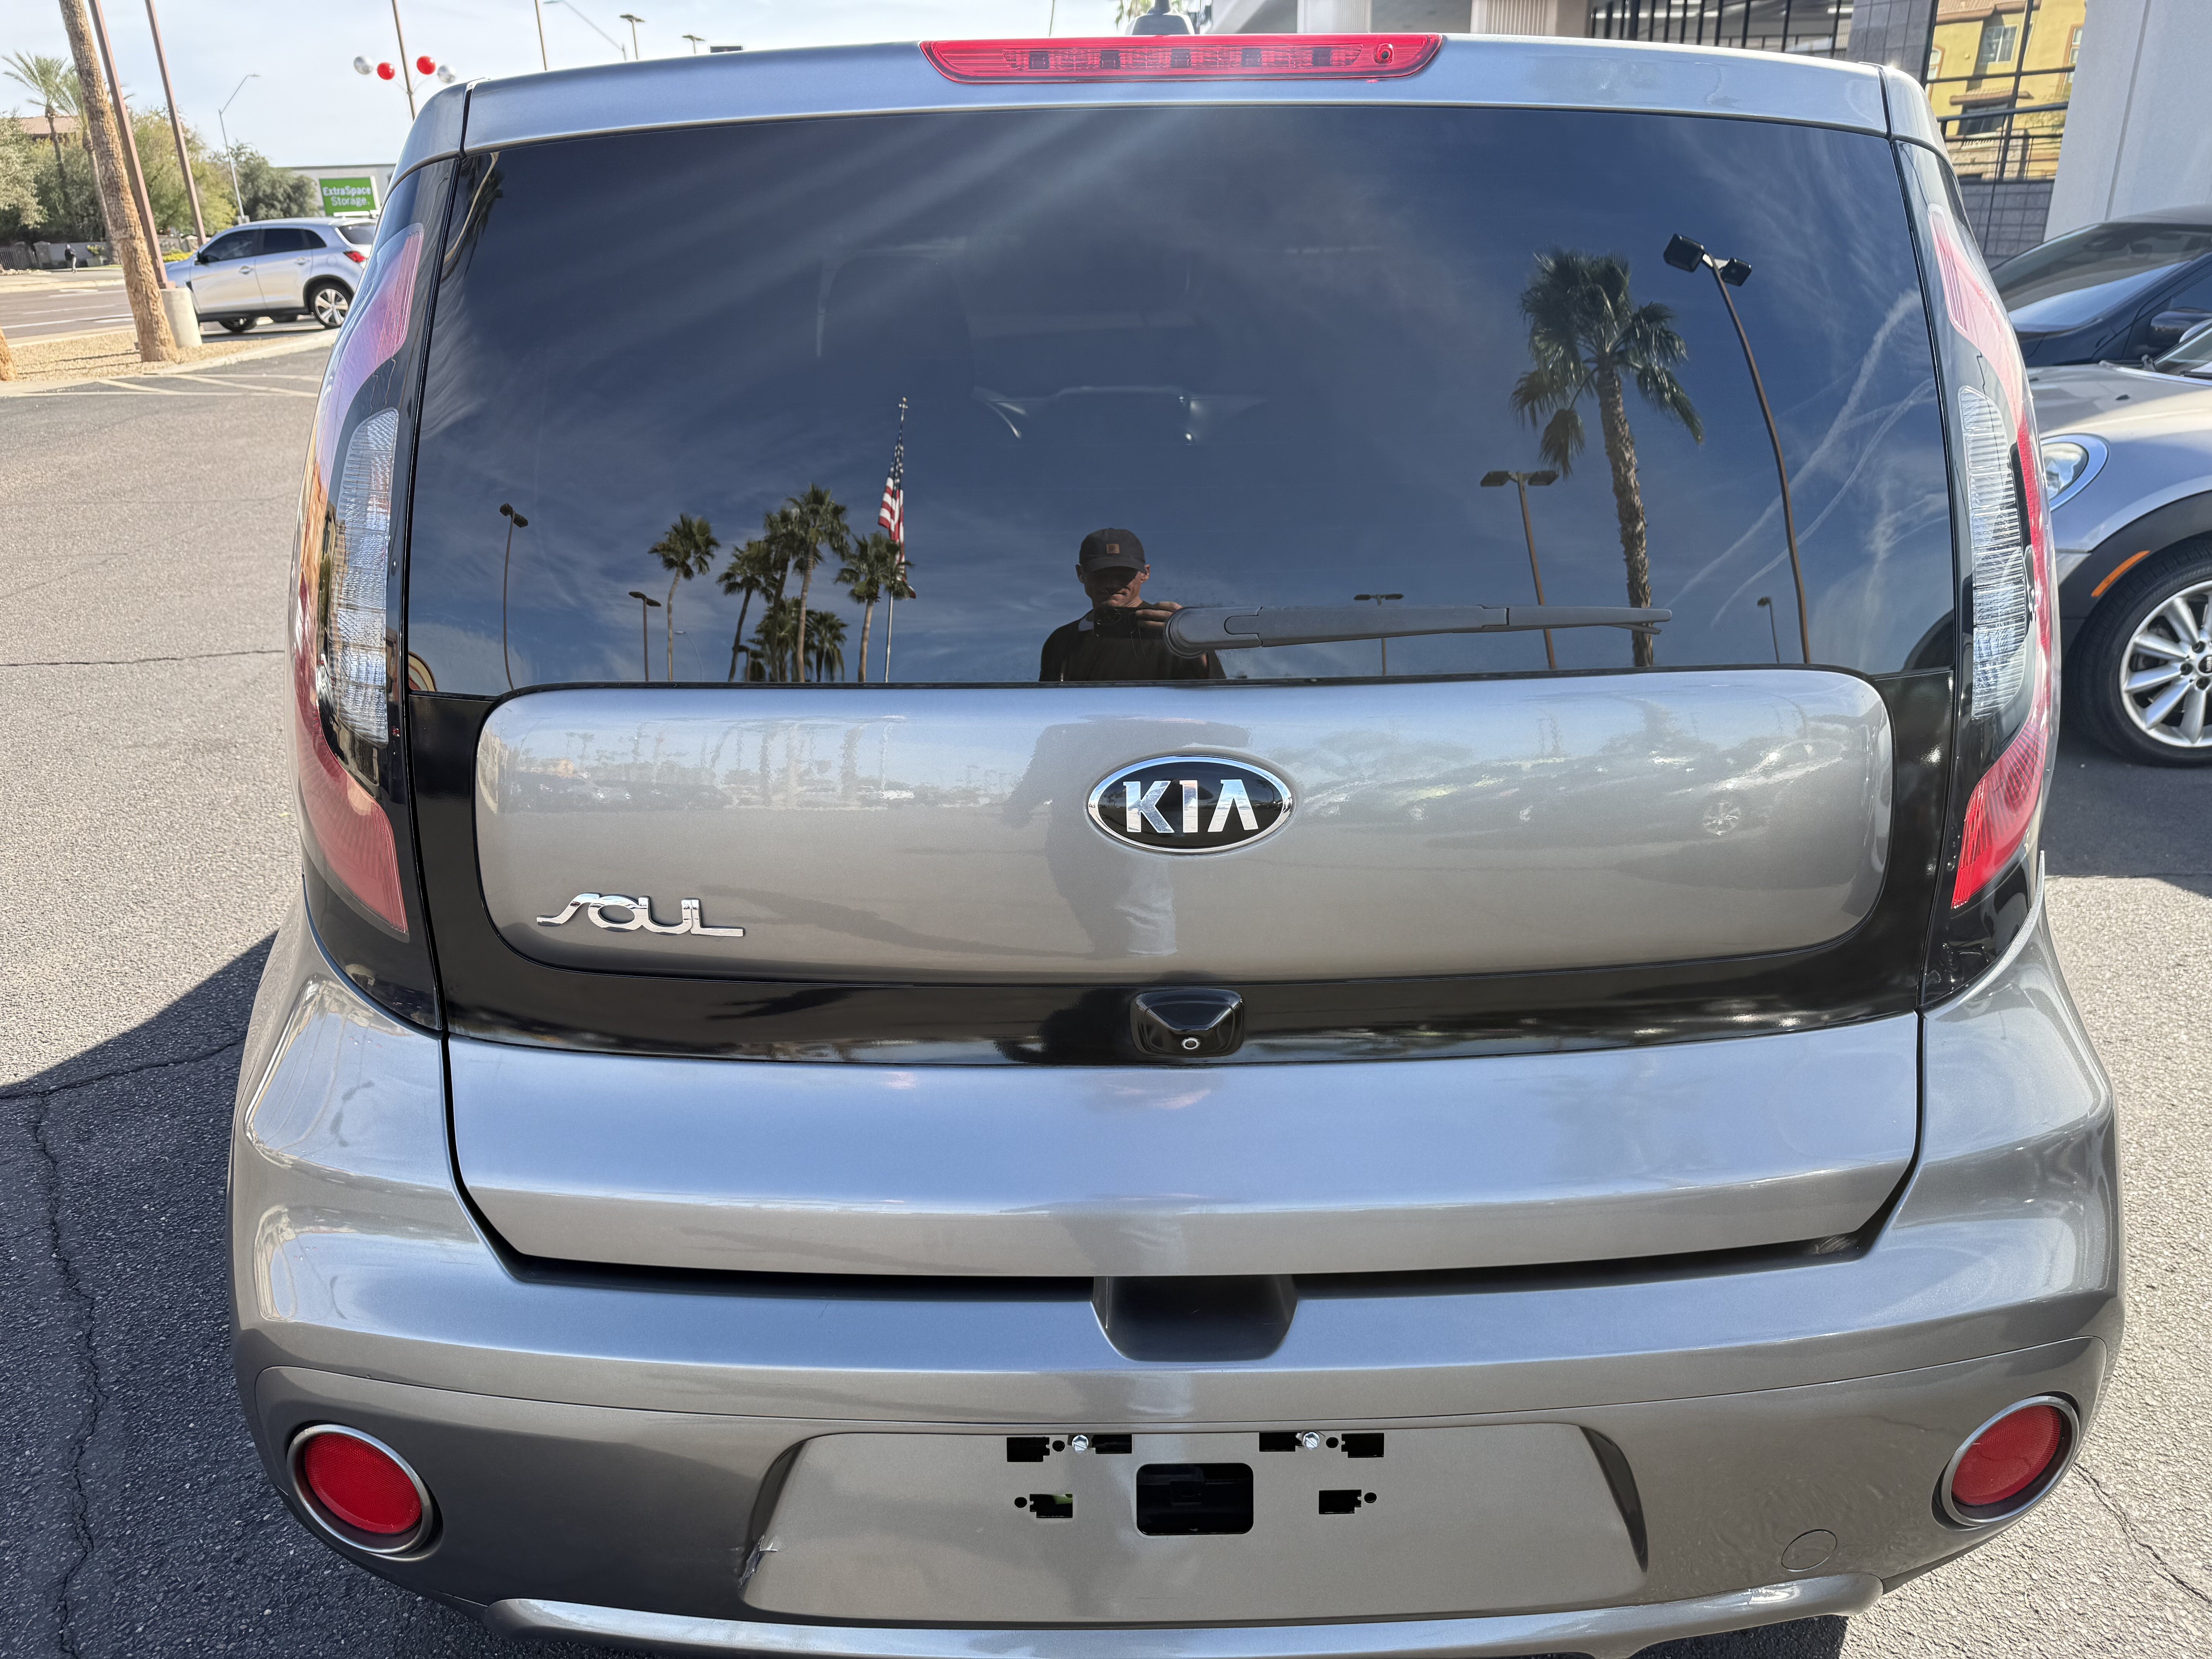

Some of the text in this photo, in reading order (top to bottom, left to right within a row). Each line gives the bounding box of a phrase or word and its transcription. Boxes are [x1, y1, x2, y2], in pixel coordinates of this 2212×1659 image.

[323, 185, 371, 197] ExtraSpace
[1123, 779, 1259, 833] KIA
[536, 892, 745, 936] SOUL
